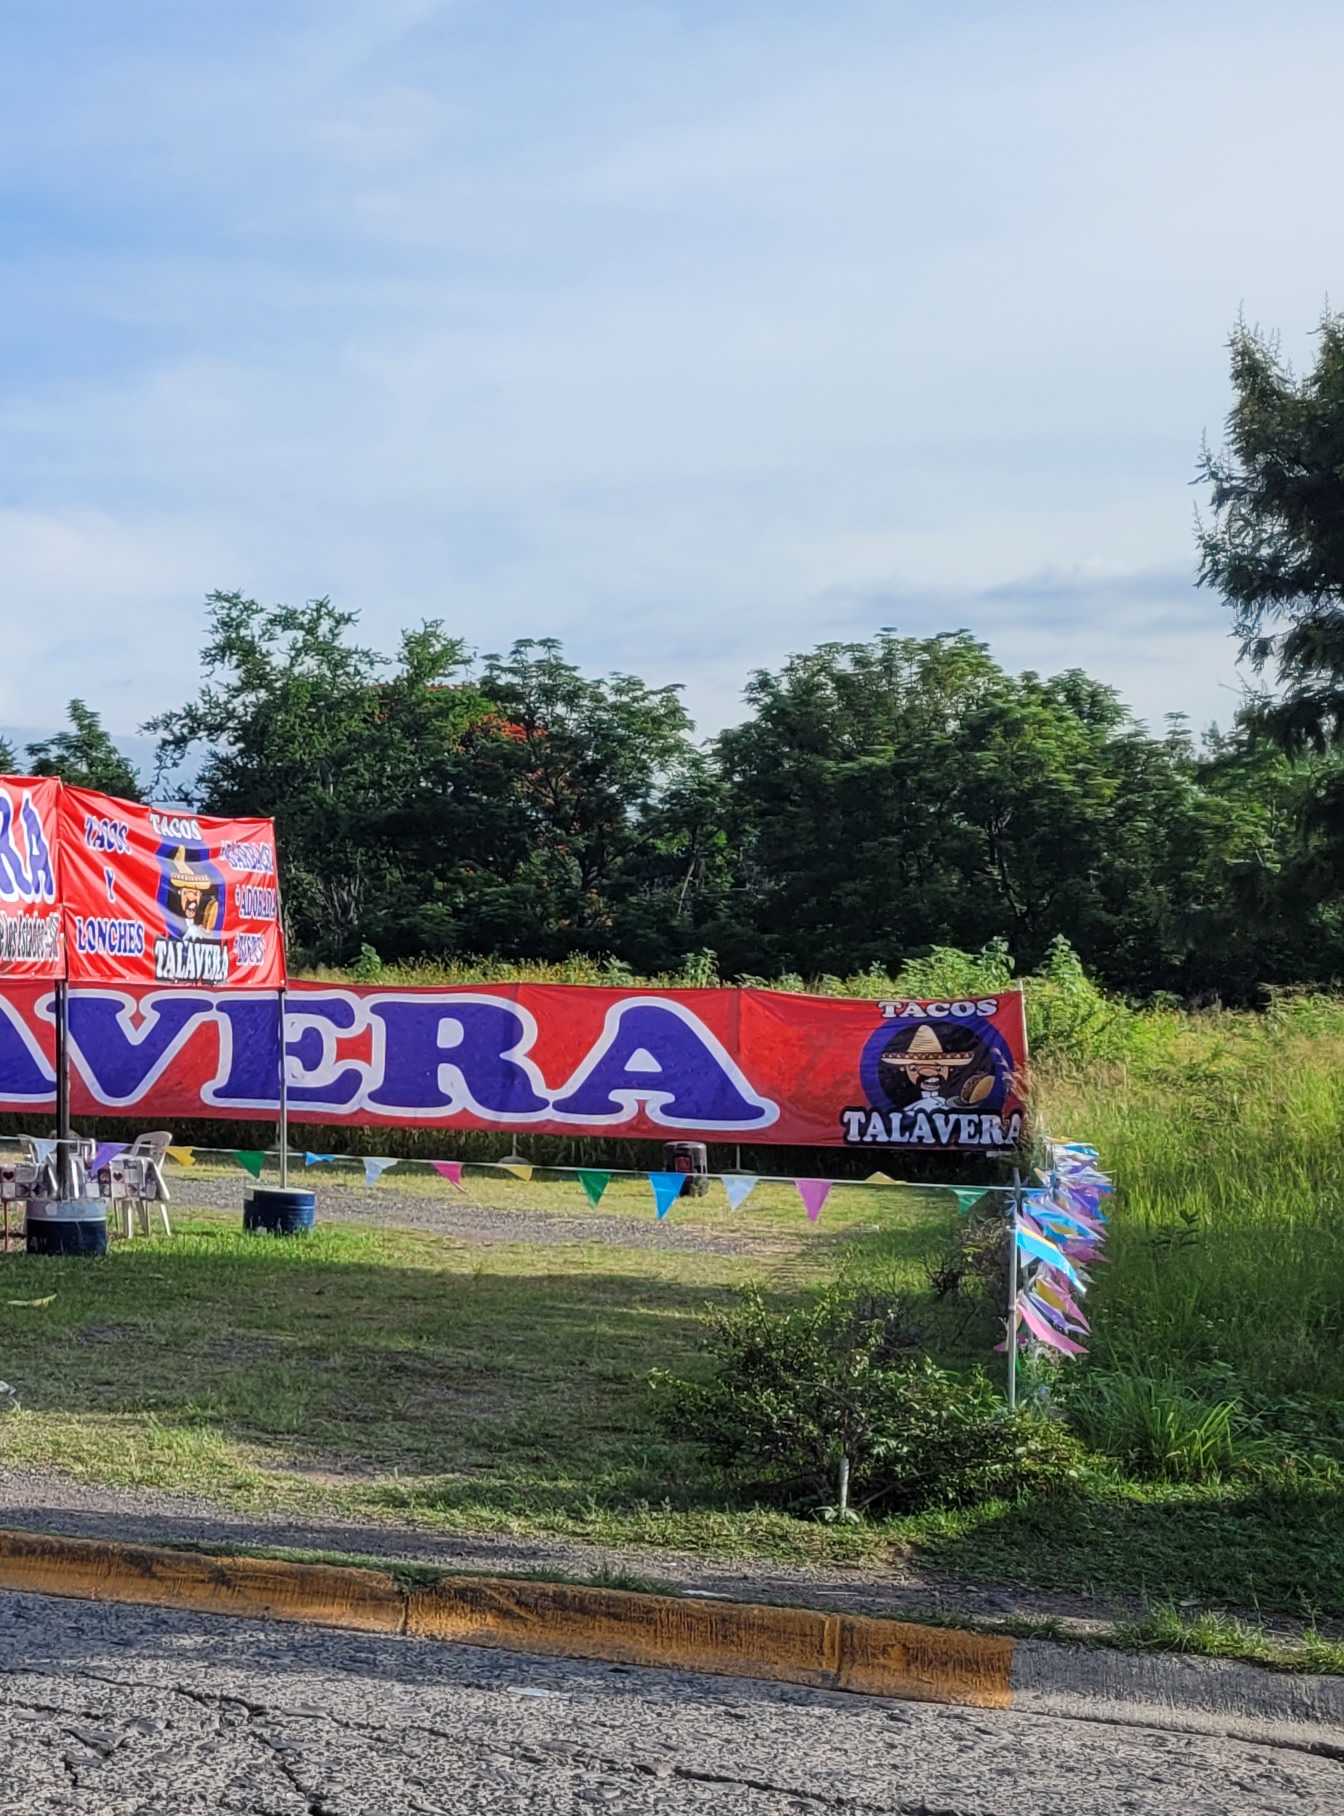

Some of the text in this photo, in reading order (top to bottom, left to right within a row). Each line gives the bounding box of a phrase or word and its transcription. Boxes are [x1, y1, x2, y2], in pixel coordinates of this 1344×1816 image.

[85, 813, 132, 855] TACOS
[149, 814, 202, 841] TACOS
[104, 866, 116, 904] Y
[75, 916, 144, 957] LONCHES
[155, 941, 229, 981] TALAVERA
[878, 999, 998, 1018] TACOS
[843, 1111, 1022, 1145] TALAVERA
